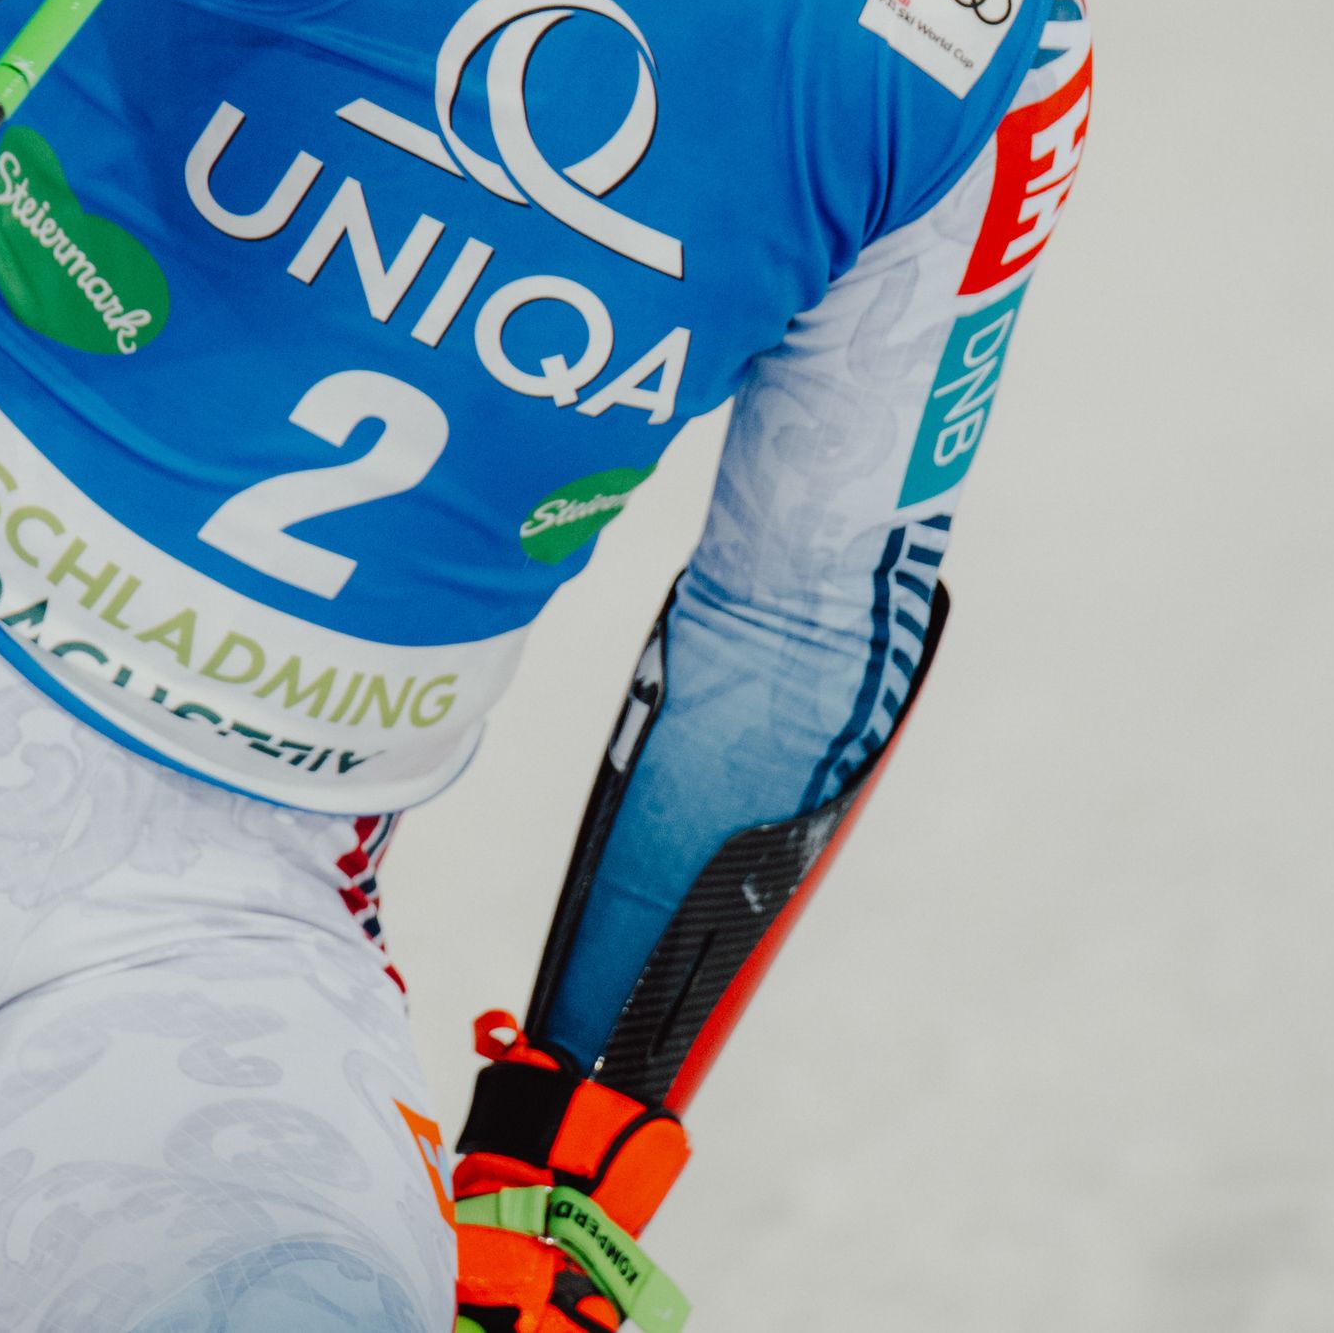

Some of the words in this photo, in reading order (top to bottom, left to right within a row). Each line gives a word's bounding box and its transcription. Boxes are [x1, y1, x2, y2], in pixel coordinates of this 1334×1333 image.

[896, 8, 916, 25] Ski
[917, 20, 954, 52] World
[953, 47, 975, 70] Cup
[184, 100, 692, 426] UNIQA
[933, 307, 1016, 466] DNB
[197, 369, 450, 600] 2
